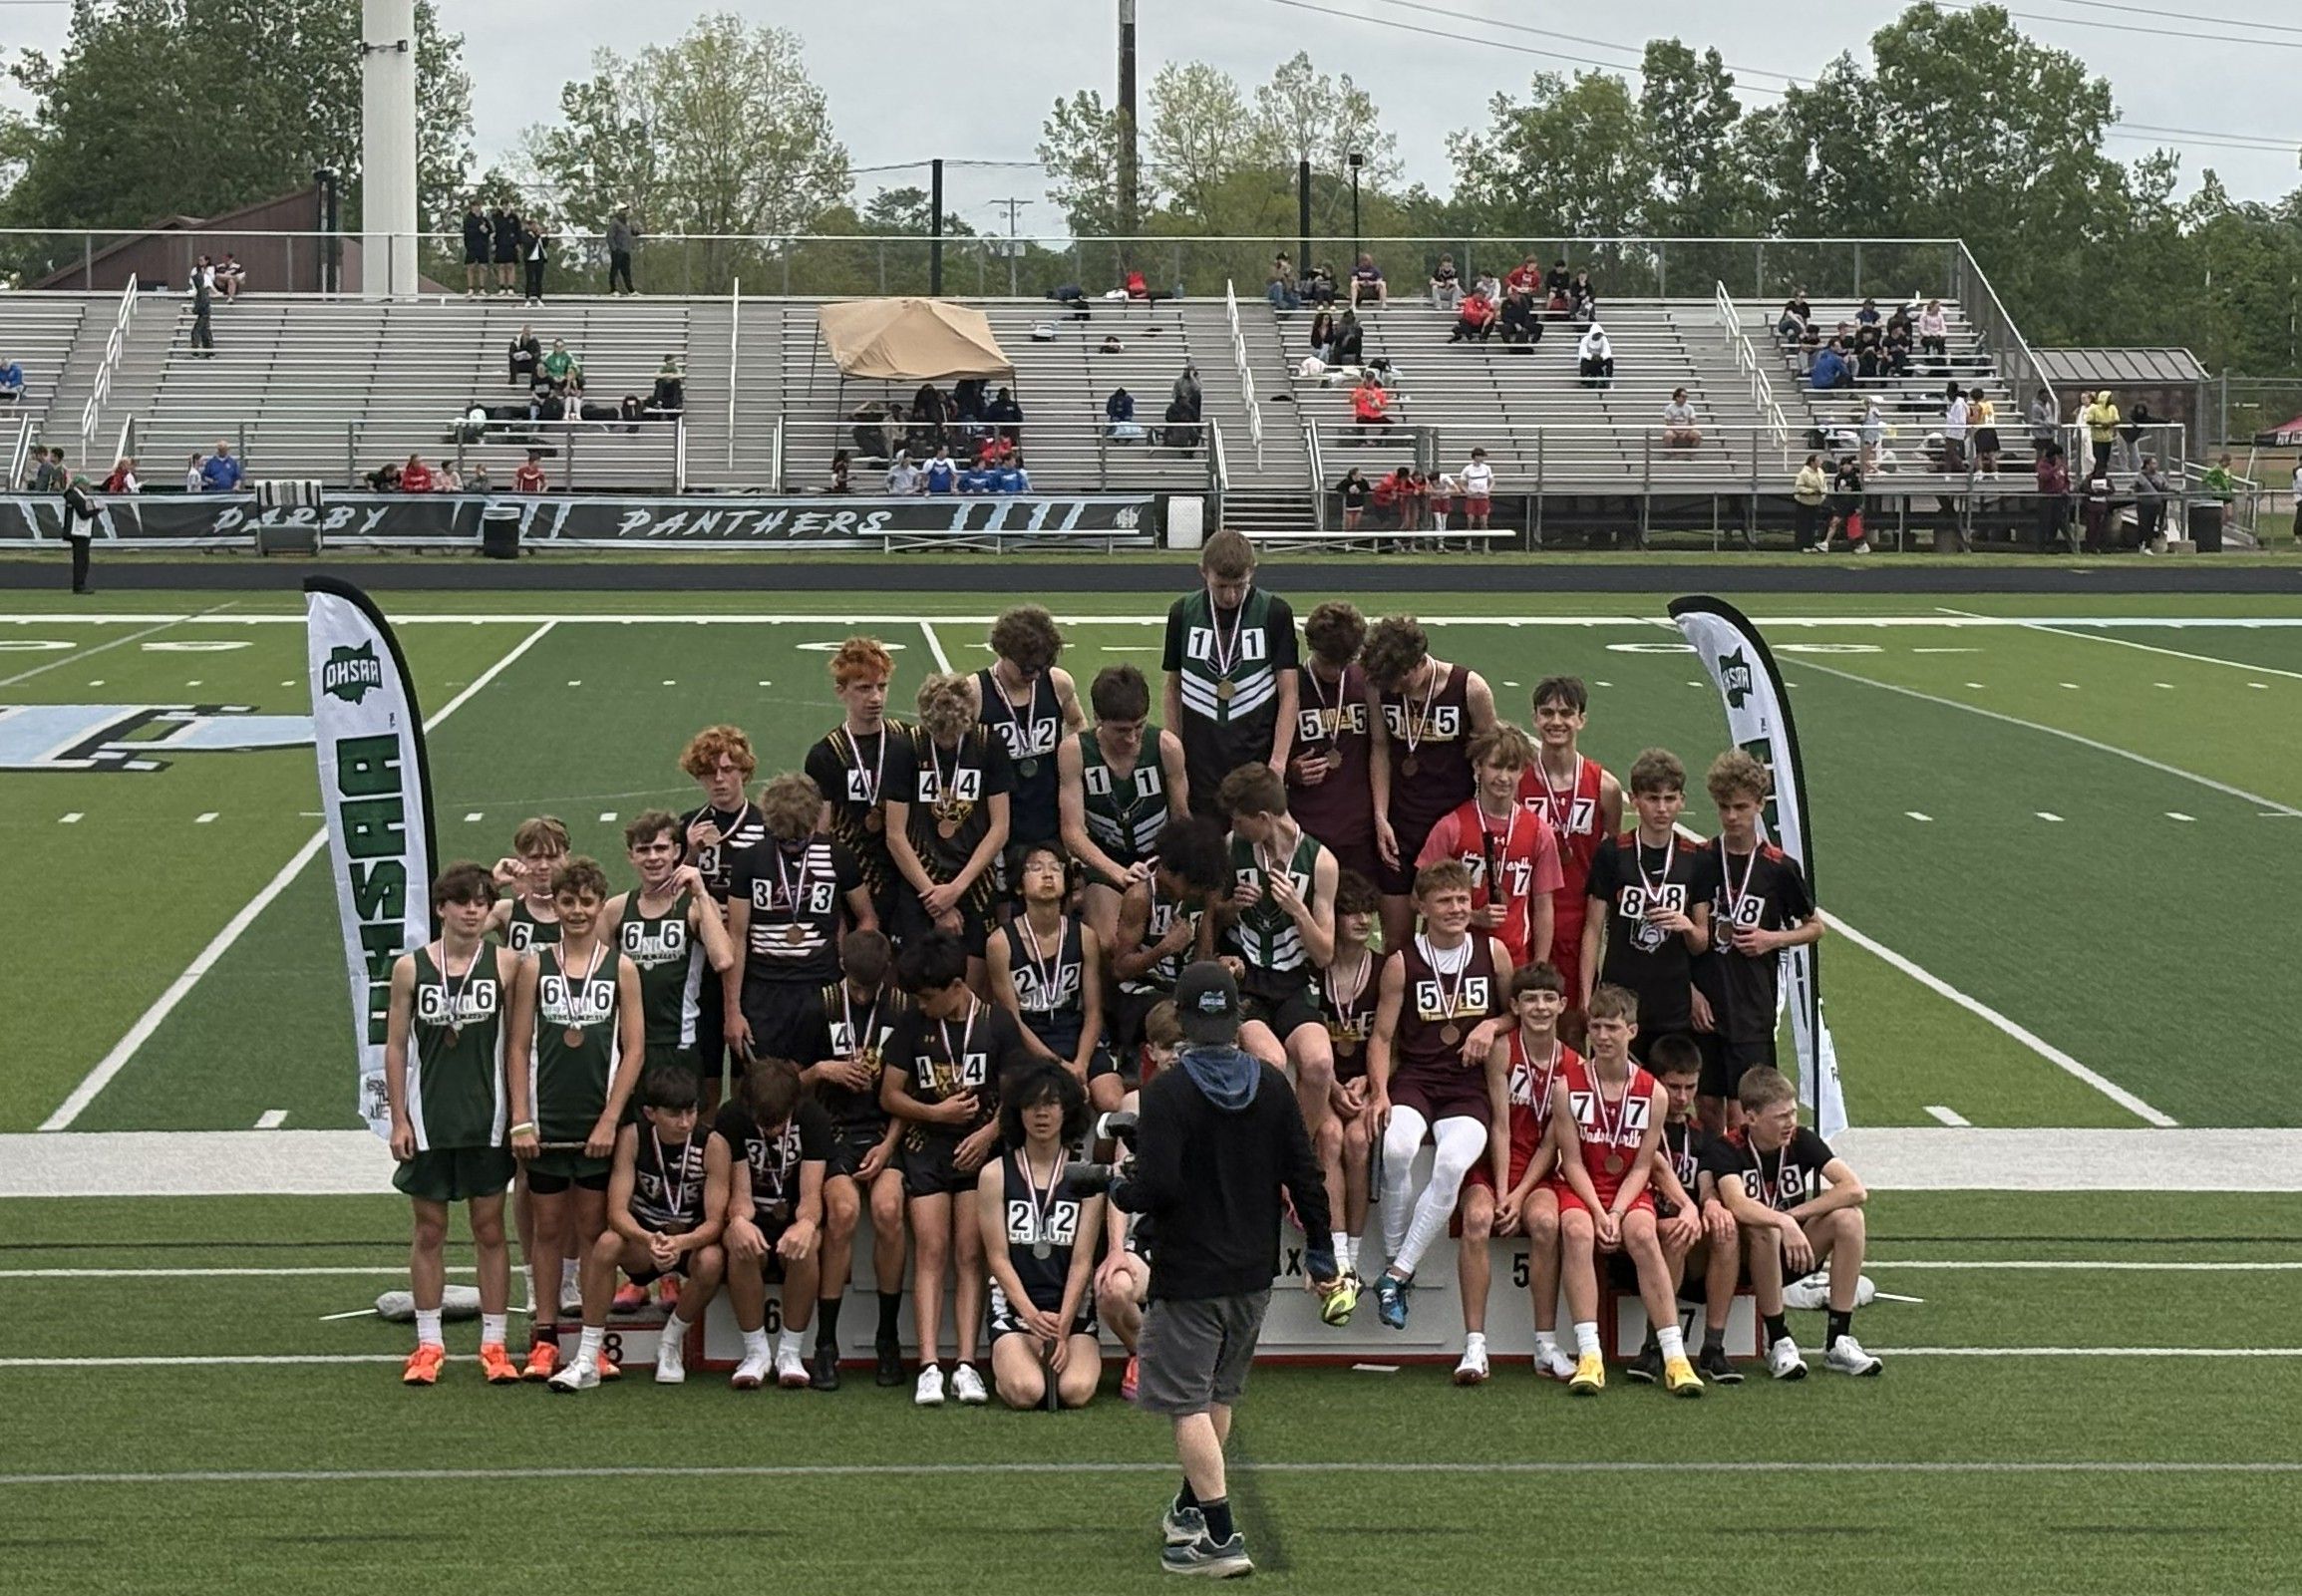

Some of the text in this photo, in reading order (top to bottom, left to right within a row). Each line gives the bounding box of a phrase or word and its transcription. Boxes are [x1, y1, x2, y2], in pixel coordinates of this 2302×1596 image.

[213, 505, 389, 533] DARBY
[617, 508, 892, 535] PANTHERS
[1193, 630, 1258, 656] 1 1
[326, 659, 380, 688] OHSAA
[1301, 712, 1319, 738] 5
[1354, 706, 1366, 731] 5
[1384, 708, 1398, 732] 5
[1439, 709, 1456, 734] 5
[998, 721, 1054, 750] 2 2
[851, 773, 868, 798] 4
[922, 772, 976, 799] 4 4
[1090, 769, 1153, 794] 1 1
[1575, 801, 1592, 826] 7
[700, 846, 716, 872] 3
[1517, 868, 1529, 893] 7
[755, 881, 769, 907] 3
[815, 884, 831, 911] 3
[1623, 888, 1641, 915] 8
[1665, 886, 1682, 911] 8
[1741, 899, 1760, 923] 8
[511, 925, 528, 951] 6
[625, 924, 640, 950] 6
[663, 922, 681, 948] 6
[543, 978, 610, 1010] 6 6
[1015, 966, 1078, 995] 2 2
[422, 987, 439, 1015] 6
[476, 982, 493, 1009] 6
[1421, 984, 1438, 1010] 5
[1470, 980, 1485, 1006] 5
[835, 1026, 851, 1052] 4
[918, 1056, 982, 1085] 4 4
[1513, 1067, 1529, 1094] 7
[1573, 1095, 1646, 1125] 7 7
[1745, 1168, 1800, 1198] 8 8
[1012, 1203, 1075, 1231] 2 2
[1513, 1252, 1530, 1288] 5
[765, 1298, 781, 1334] 6
[603, 1333, 623, 1364] 8
